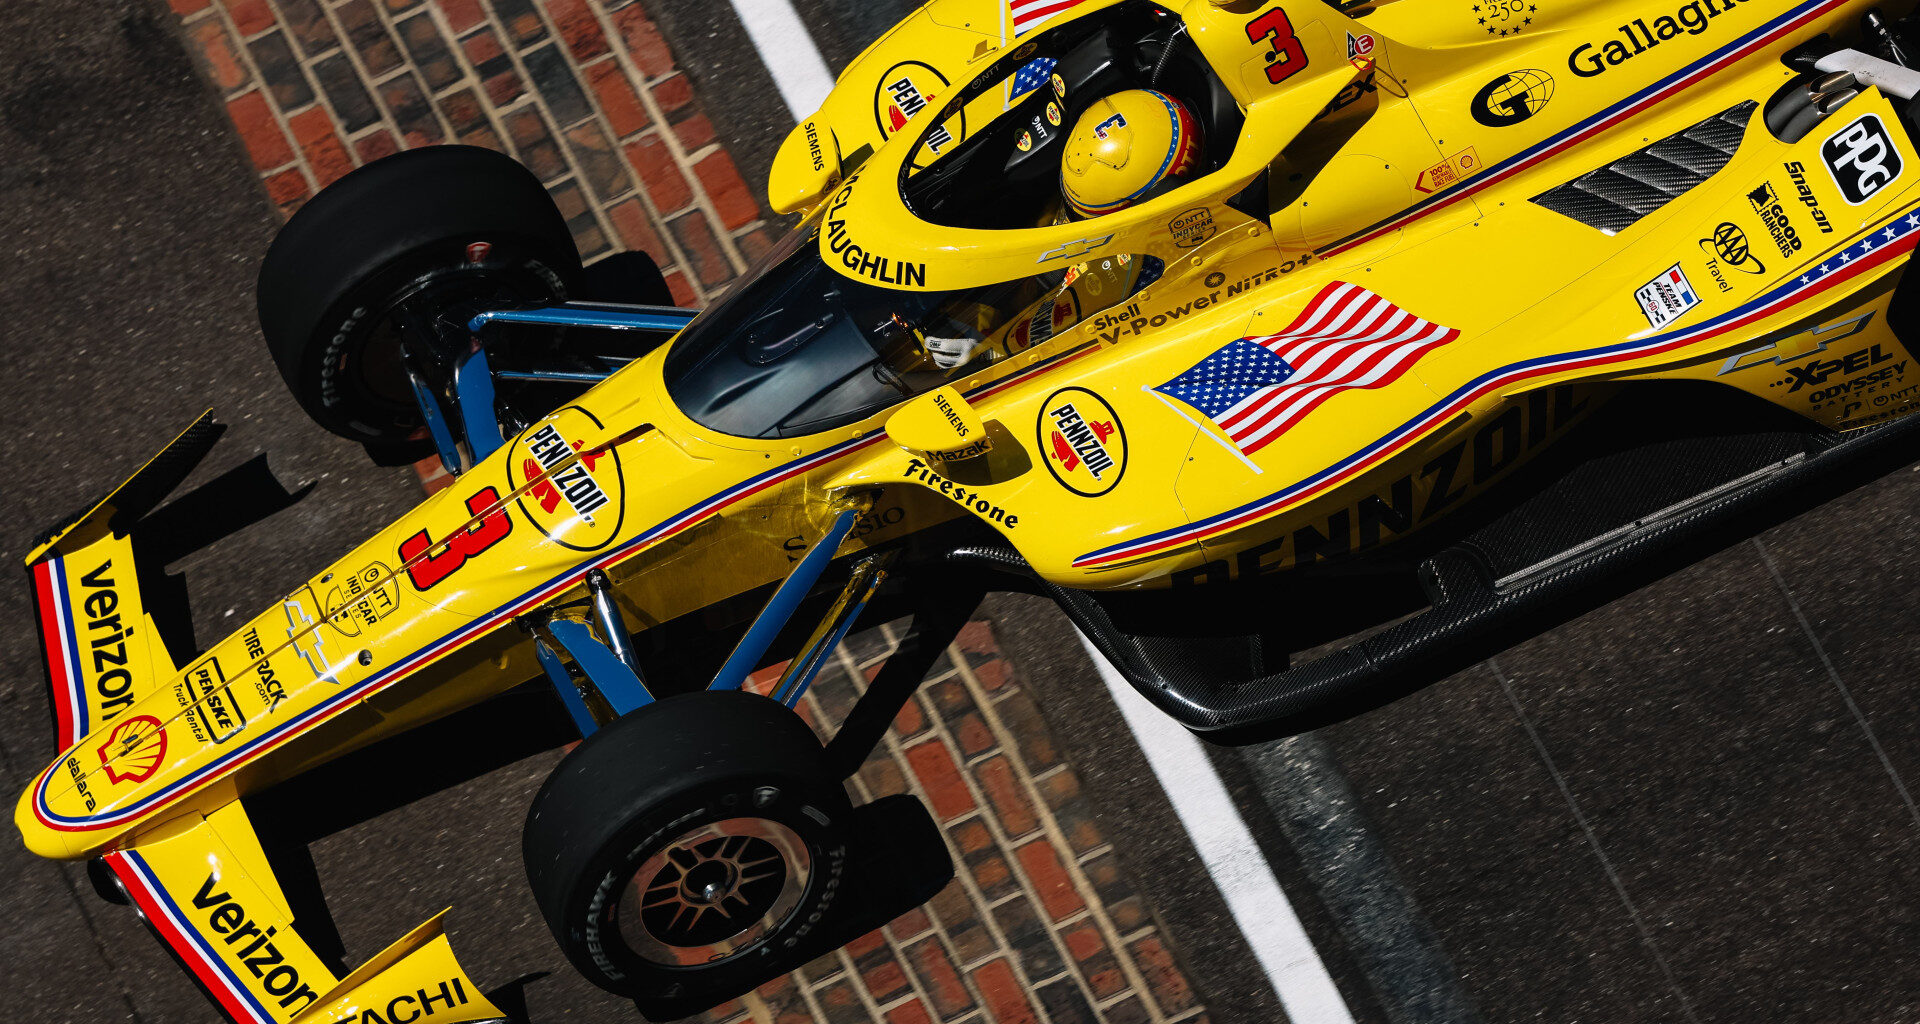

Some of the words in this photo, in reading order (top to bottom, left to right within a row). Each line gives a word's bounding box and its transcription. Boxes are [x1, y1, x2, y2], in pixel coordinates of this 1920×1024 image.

[1488, 0, 1524, 21] 250
[1245, 6, 1309, 85] 3
[1358, 37, 1372, 53] E
[1568, 0, 1752, 78] Gallagh
[886, 77, 953, 154] PENNOIL
[1034, 122, 1048, 139] NTT
[804, 122, 825, 171] SIEMENS
[1429, 163, 1451, 177] 100%
[1832, 121, 1892, 197] PPG
[1185, 211, 1205, 225] NTT
[1783, 161, 1834, 234] Snap-on
[1173, 218, 1213, 240] INDYCAR
[1715, 224, 1749, 265] AAA
[1760, 209, 1794, 258] RANCHERS
[1771, 204, 1802, 251] GOOD
[1653, 281, 1677, 315] PENSKE
[1664, 283, 1682, 308] TEAM
[1706, 258, 1734, 293] Travel
[1094, 303, 1141, 331] Shell
[1099, 289, 1221, 345] V-Power
[1785, 343, 1893, 393] XPEL
[1808, 360, 1908, 403] ODYSSEY
[1890, 384, 1920, 401] NTT
[933, 394, 970, 437] SIEMENS
[1812, 375, 1904, 412] BATTERY
[925, 439, 990, 461] Mazak
[1050, 402, 1115, 478] PENNZOIL
[903, 459, 1018, 529] Firestone
[398, 485, 513, 591] 3
[344, 590, 362, 619] SEES
[346, 575, 377, 626] INDCAR
[80, 558, 135, 722] verizon
[173, 683, 189, 708] Truck
[185, 708, 208, 743] Rental
[195, 668, 234, 729] PENSKE
[67, 757, 97, 812] dallara
[784, 844, 846, 949] Firestone
[192, 871, 319, 1018] verizon
